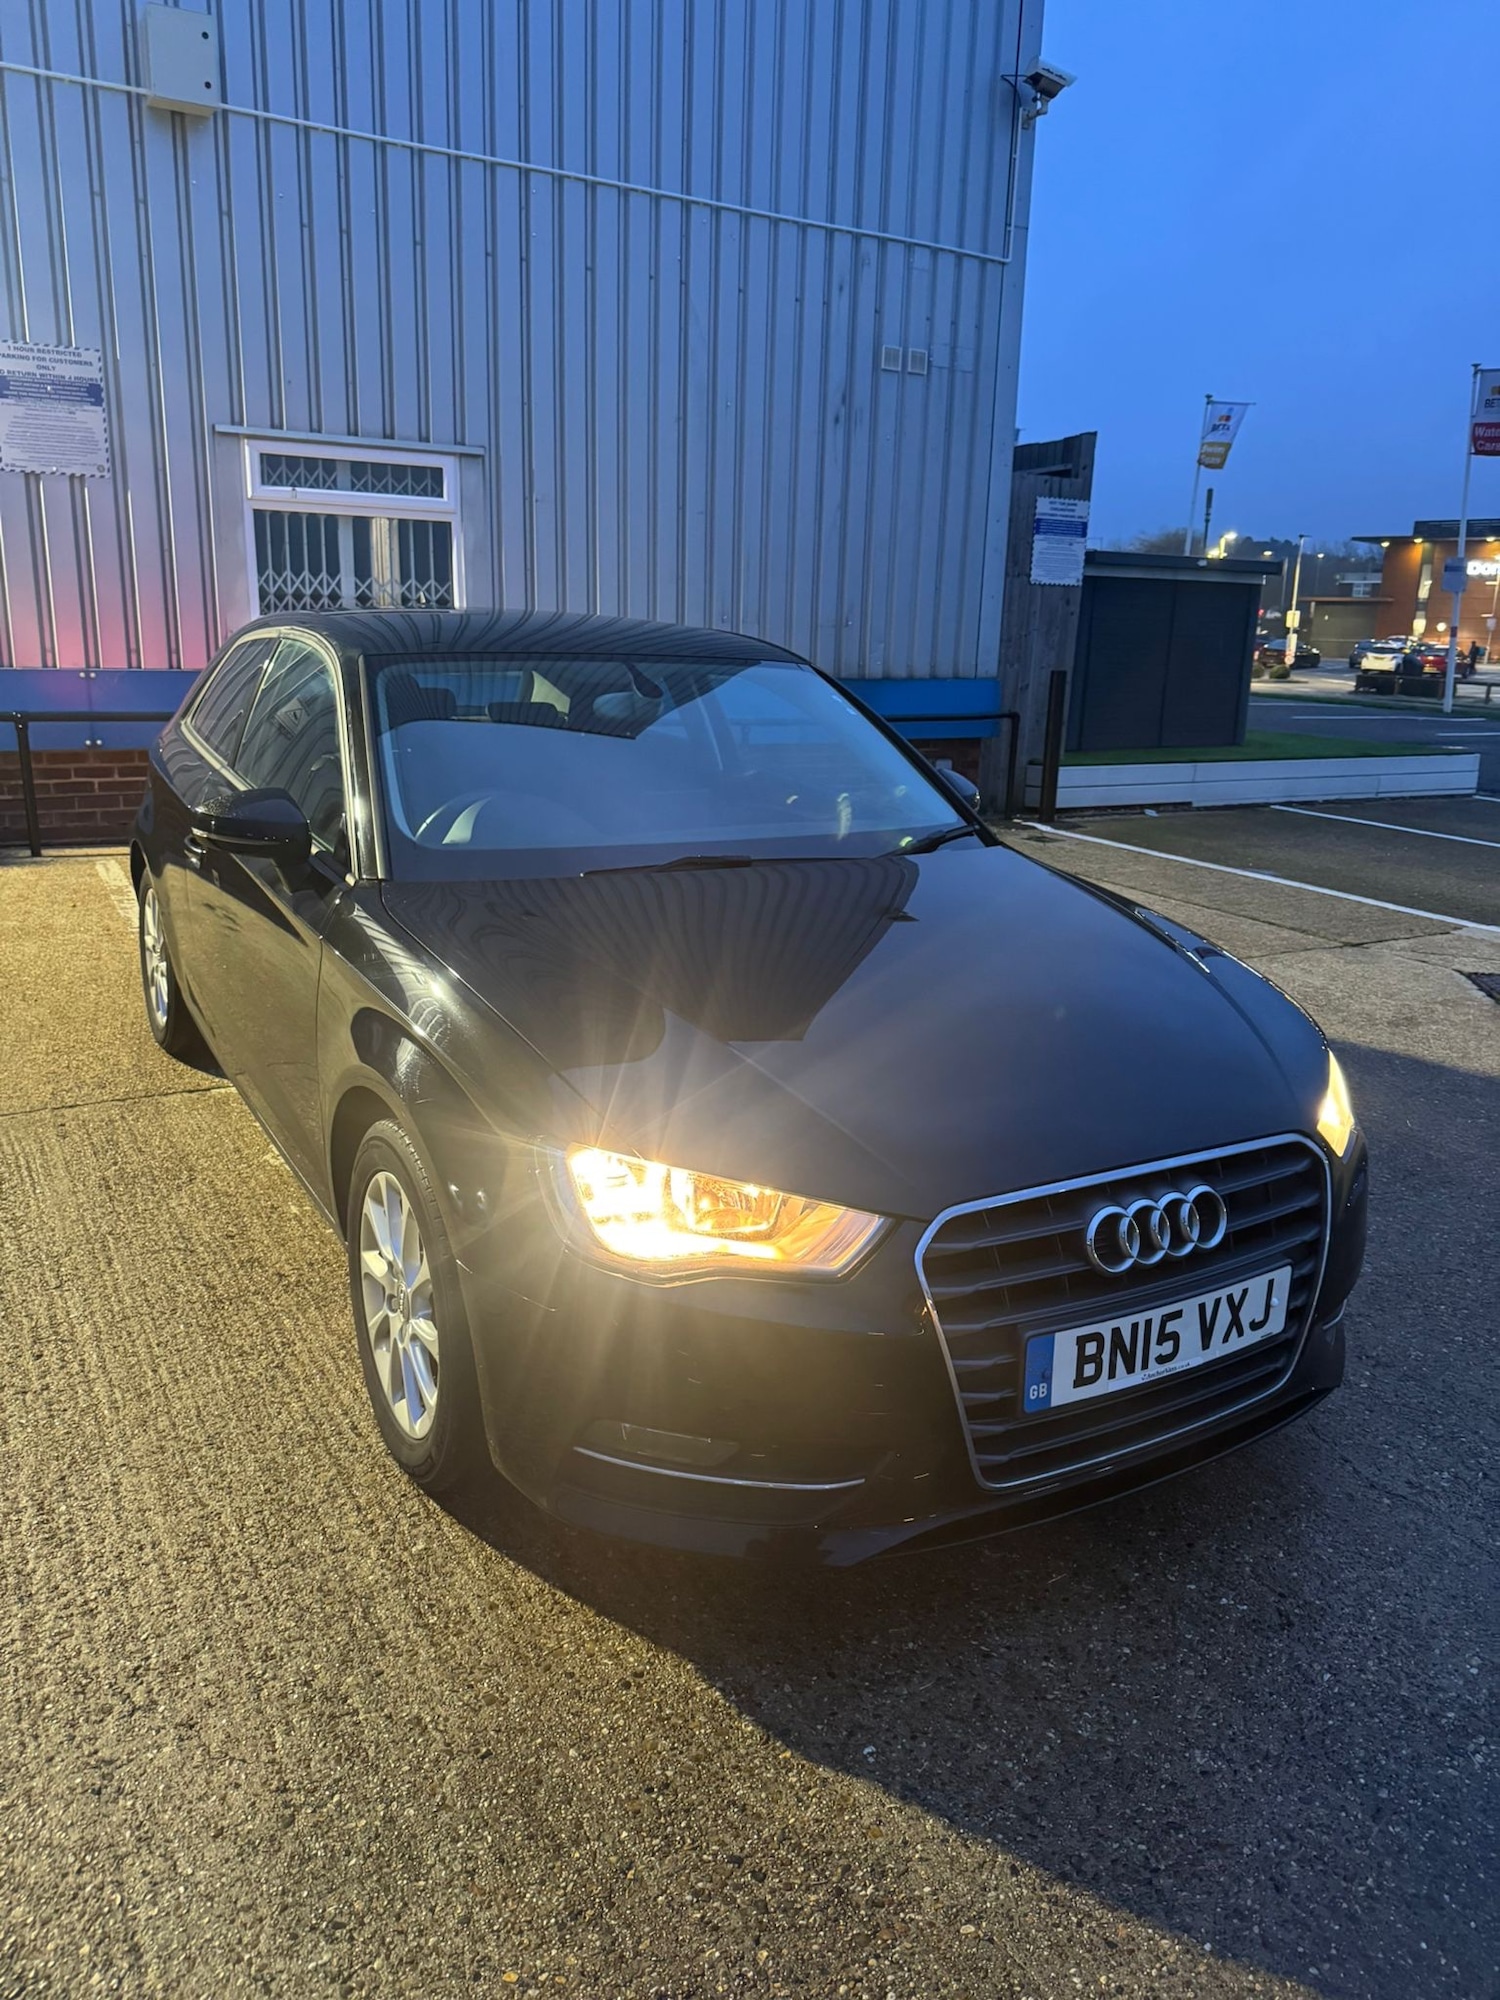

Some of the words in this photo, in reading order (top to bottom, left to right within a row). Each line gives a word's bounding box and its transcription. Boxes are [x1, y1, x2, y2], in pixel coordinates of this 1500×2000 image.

[37, 347, 82, 358] RESTRICTED
[48, 357, 93, 367] CUSTOMERS
[7, 369, 37, 378] RETURN
[39, 372, 66, 380] WITHIN
[1073, 1309, 1183, 1389] BN15
[1198, 1278, 1275, 1351] VXJ
[1029, 1383, 1048, 1400] GB
